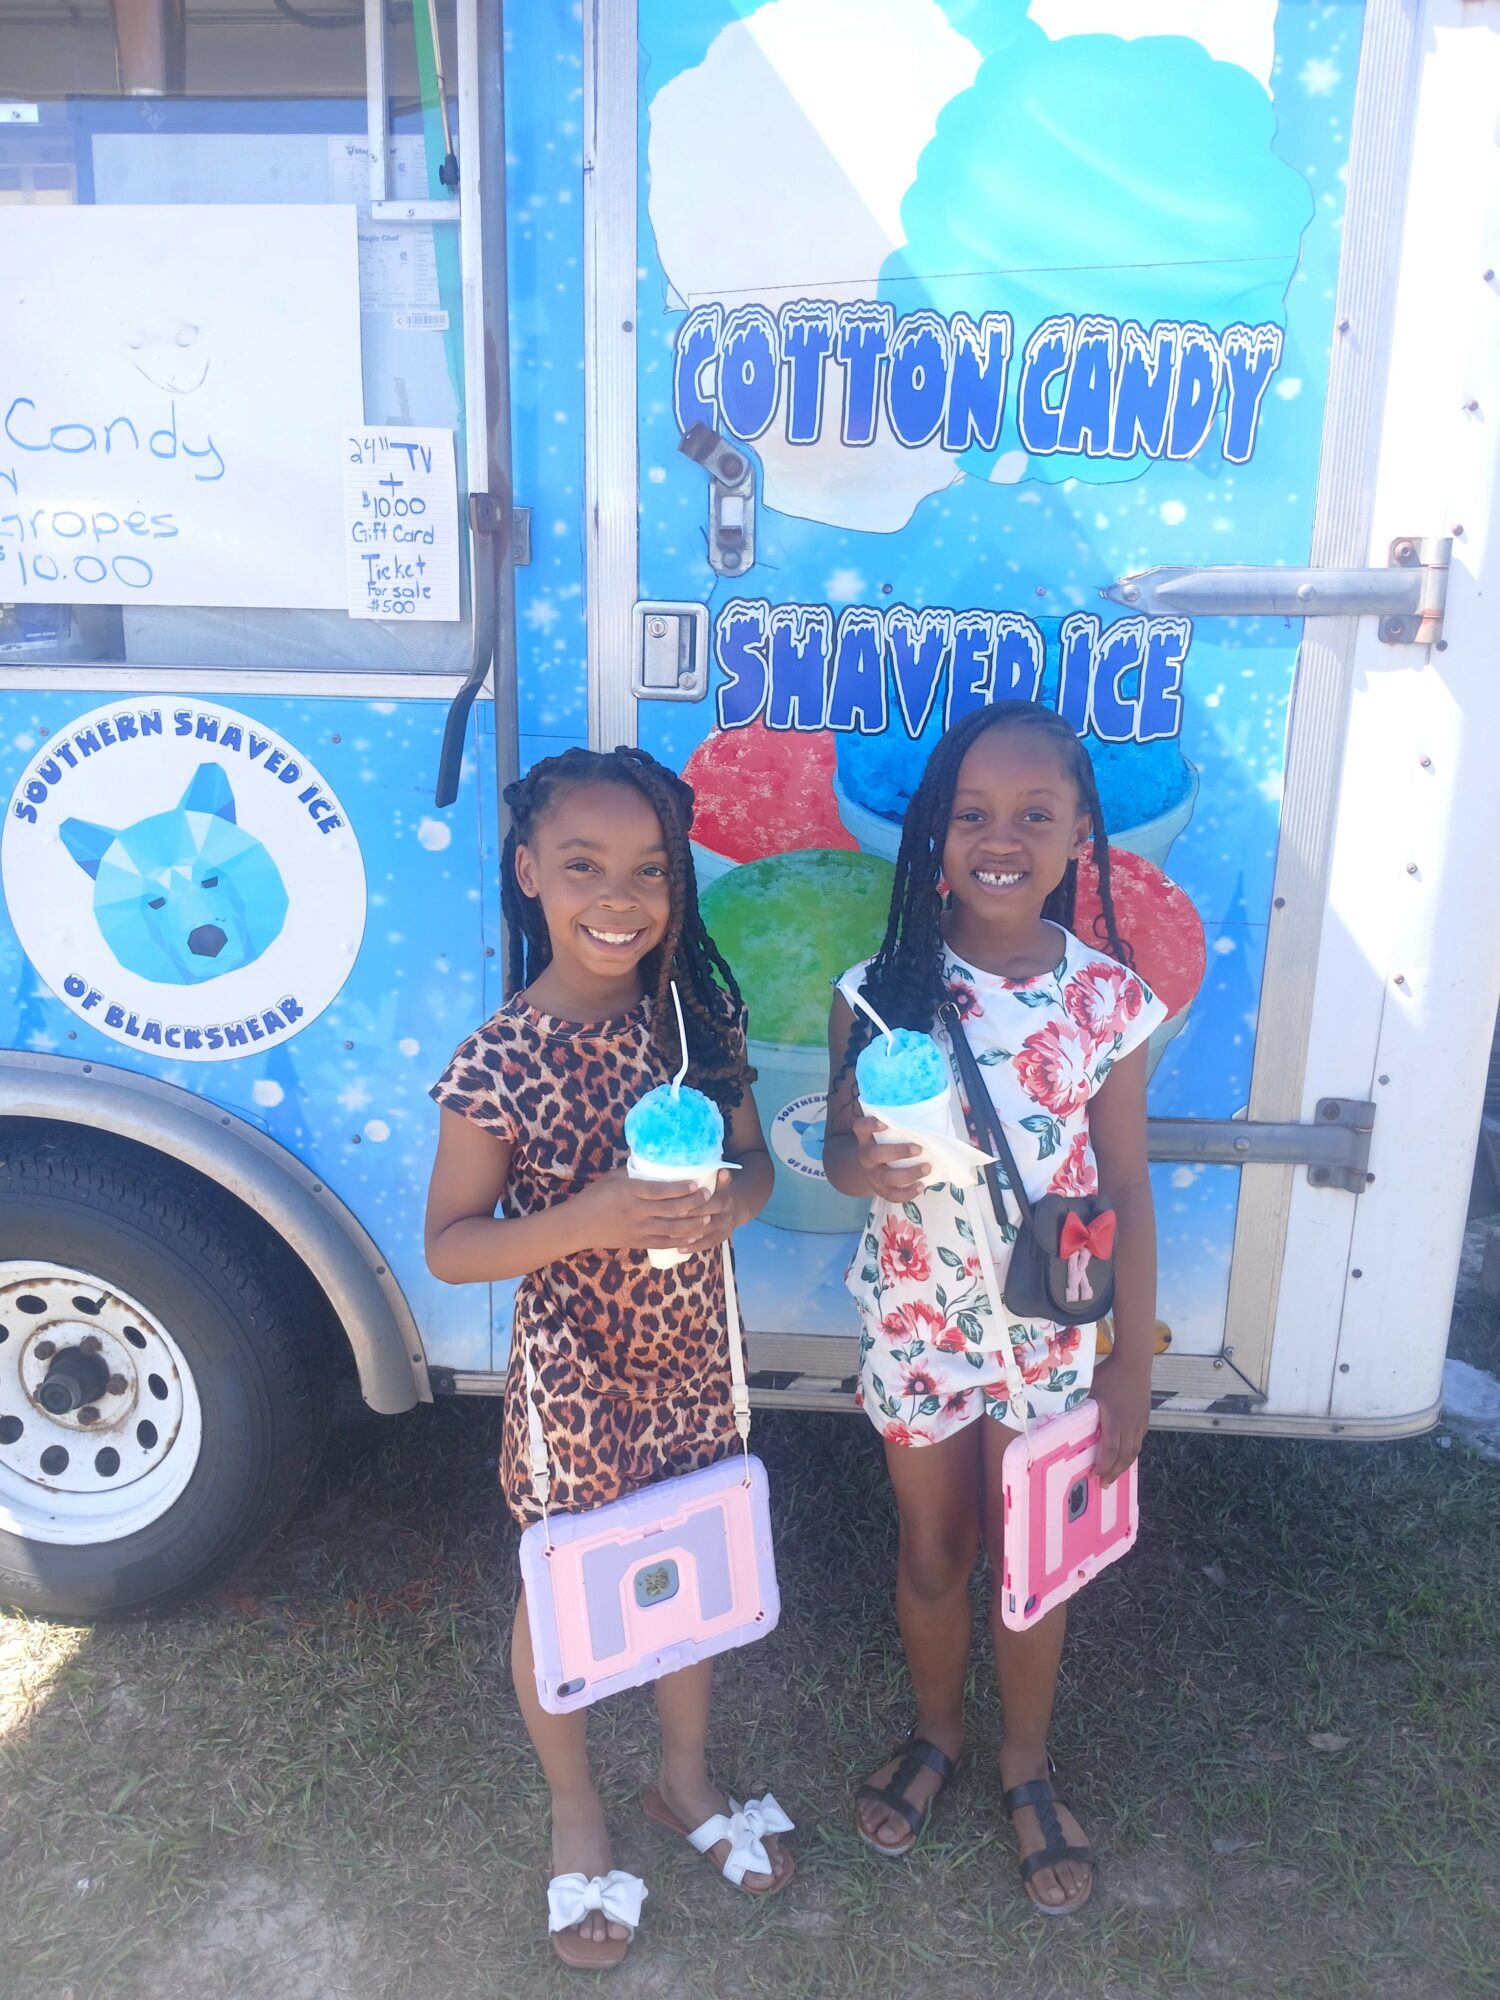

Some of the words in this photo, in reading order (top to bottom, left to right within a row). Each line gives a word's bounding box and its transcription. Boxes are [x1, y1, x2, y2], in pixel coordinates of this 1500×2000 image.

[672, 300, 1012, 452] COTTON
[1016, 313, 1285, 466] CANDY
[4, 396, 226, 482] Candy
[389, 442, 432, 474] TV
[352, 521, 388, 544] Gift
[392, 523, 435, 545] Card
[361, 553, 427, 582] Ticket
[716, 597, 1046, 740] SHAVED
[1057, 610, 1193, 744] ICE
[13, 709, 164, 824] SOUTHERN
[174, 709, 303, 785] SHAVED
[297, 782, 346, 835] ICE
[63, 973, 105, 1011] OF
[104, 995, 304, 1051] BLACKSHEAR
[787, 1157, 801, 1169] OF
[800, 1165, 827, 1178] BLAC
